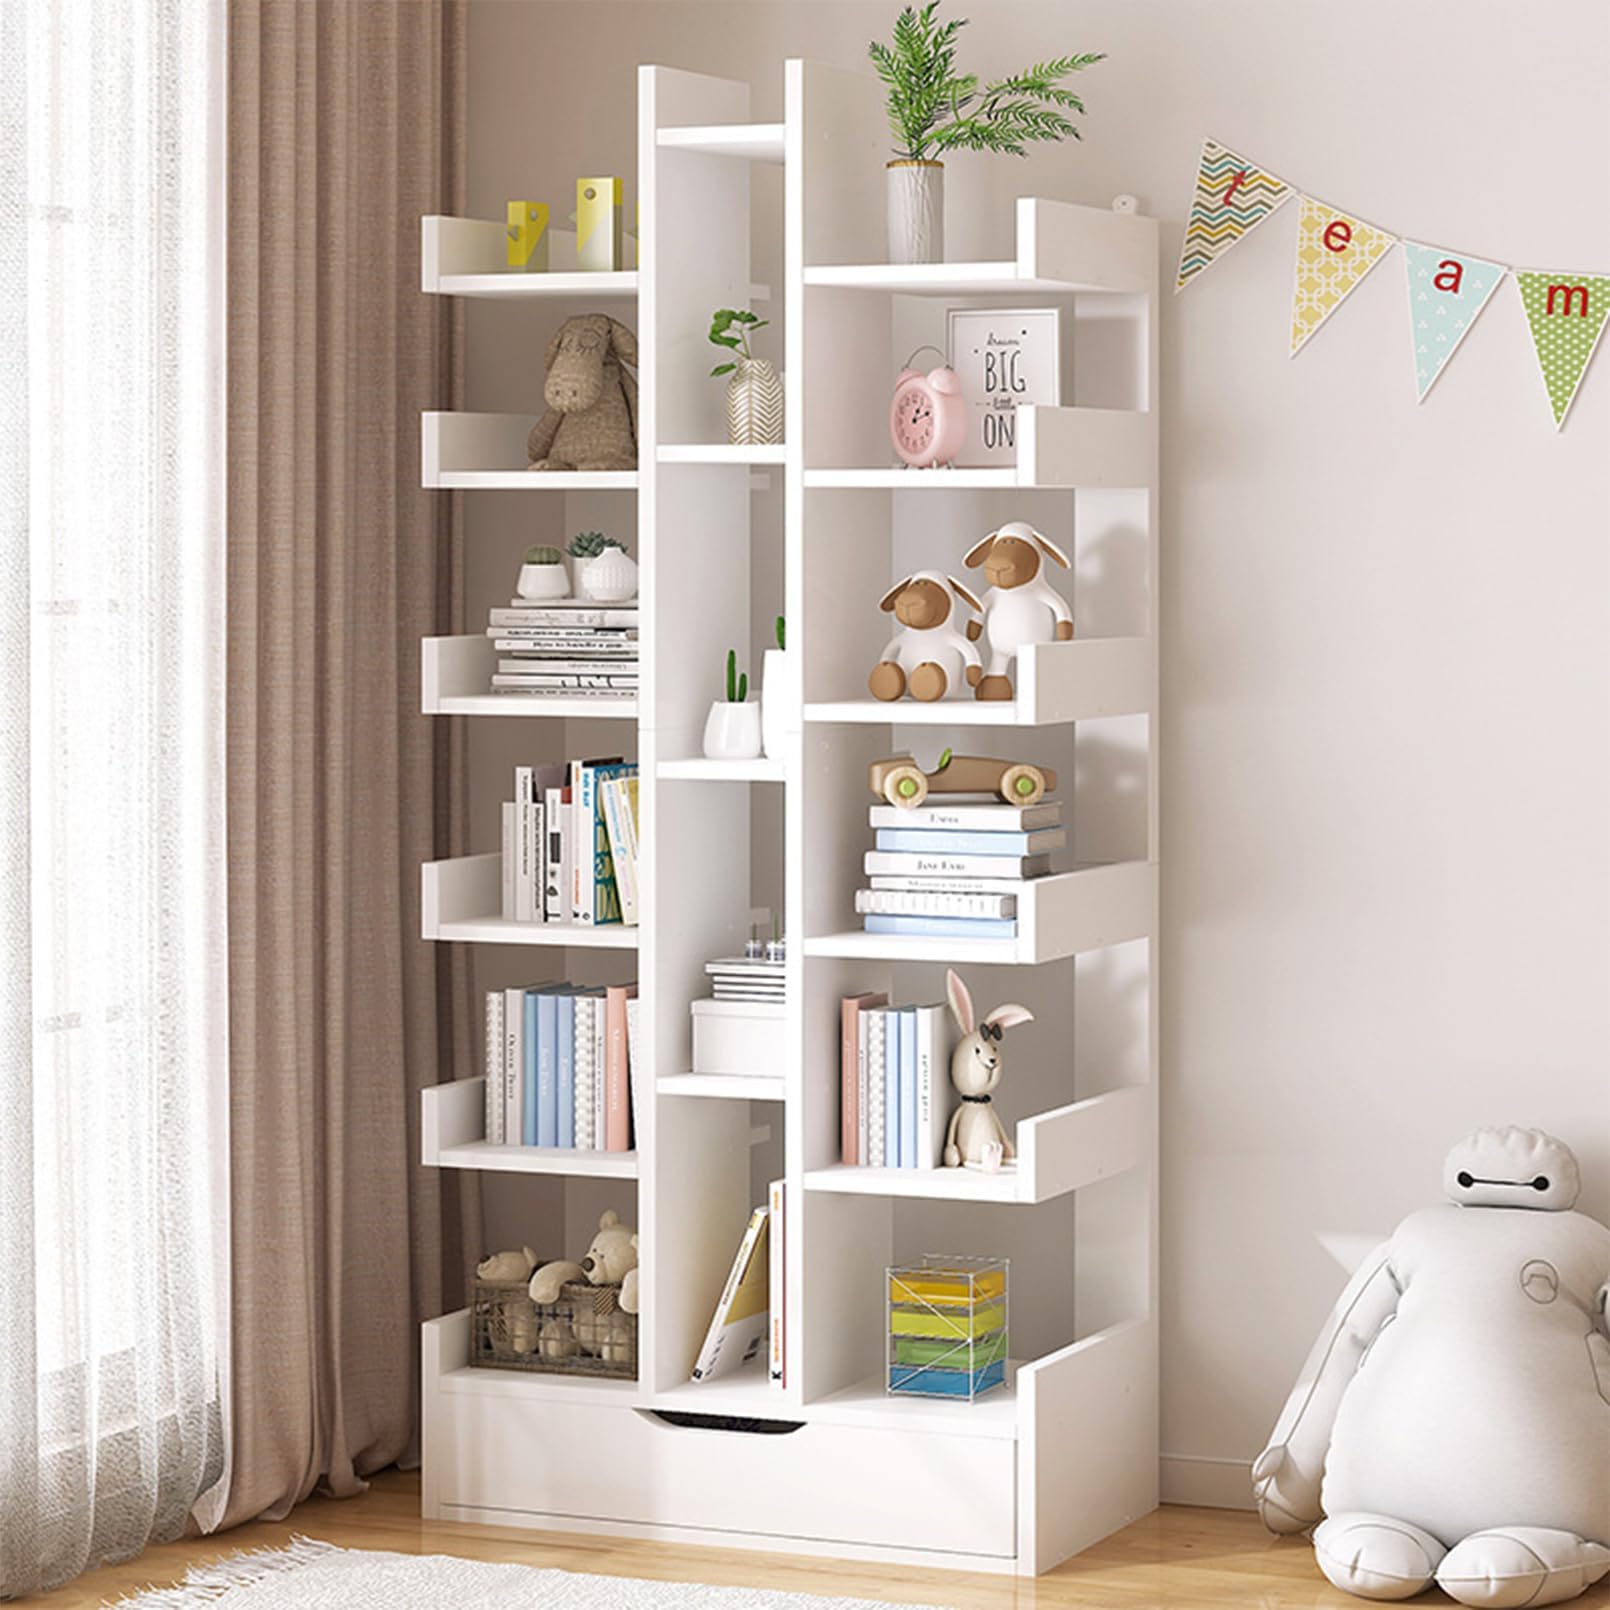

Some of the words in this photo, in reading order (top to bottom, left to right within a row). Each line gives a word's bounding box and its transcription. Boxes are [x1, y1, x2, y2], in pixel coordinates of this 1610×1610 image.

[1222, 170, 1246, 207] t
[1322, 220, 1353, 253] e
[1433, 259, 1464, 294] a
[1545, 284, 1590, 318] m
[985, 350, 1026, 393] BIG
[983, 413, 1015, 449] ON
